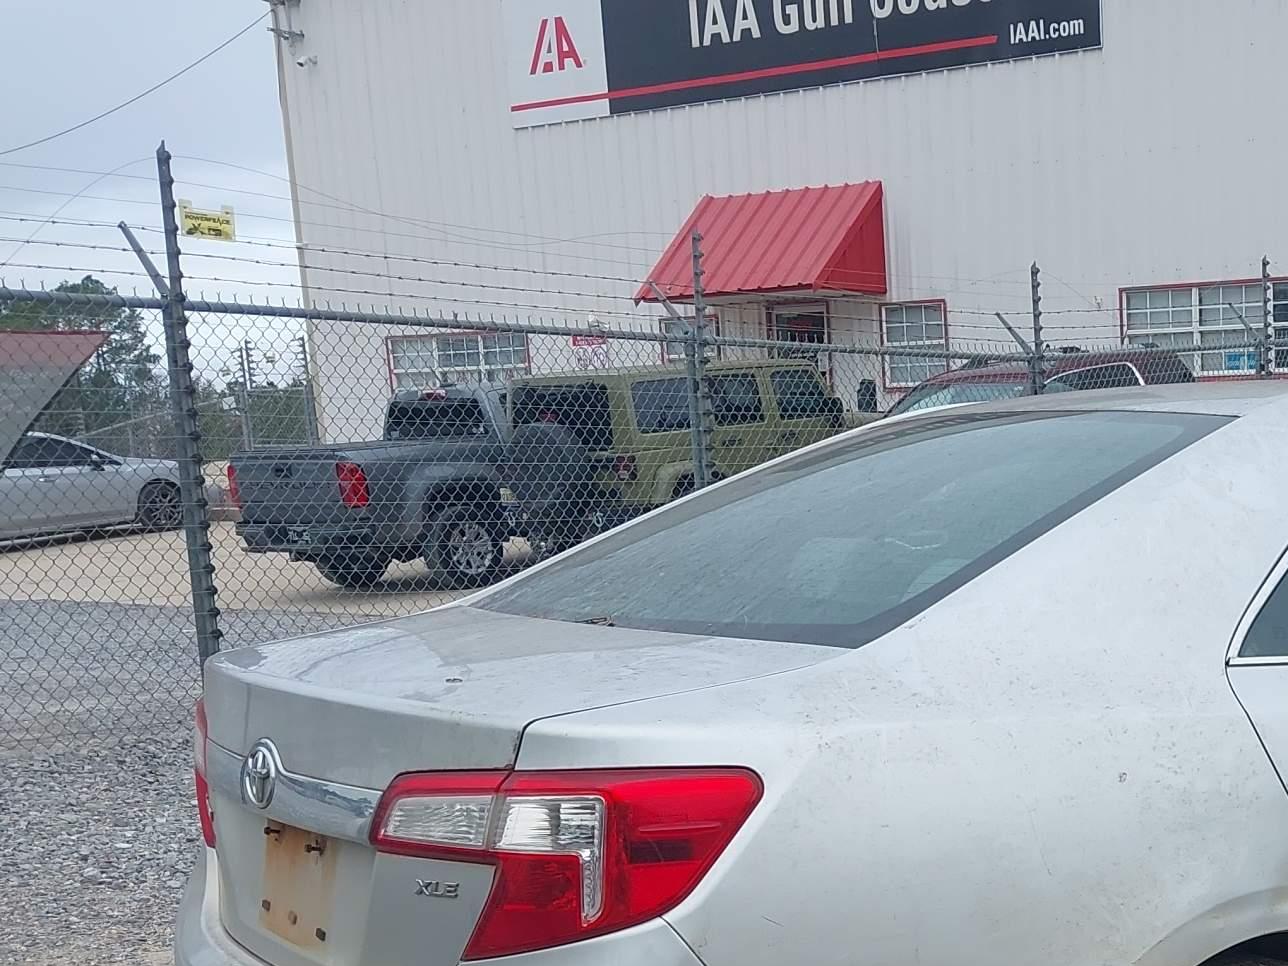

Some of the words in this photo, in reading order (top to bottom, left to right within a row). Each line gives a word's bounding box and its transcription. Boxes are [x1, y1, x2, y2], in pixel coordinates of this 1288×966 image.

[688, 0, 761, 48] IAA
[1009, 18, 1084, 45] IAAI.com
[414, 878, 460, 899] XLE
